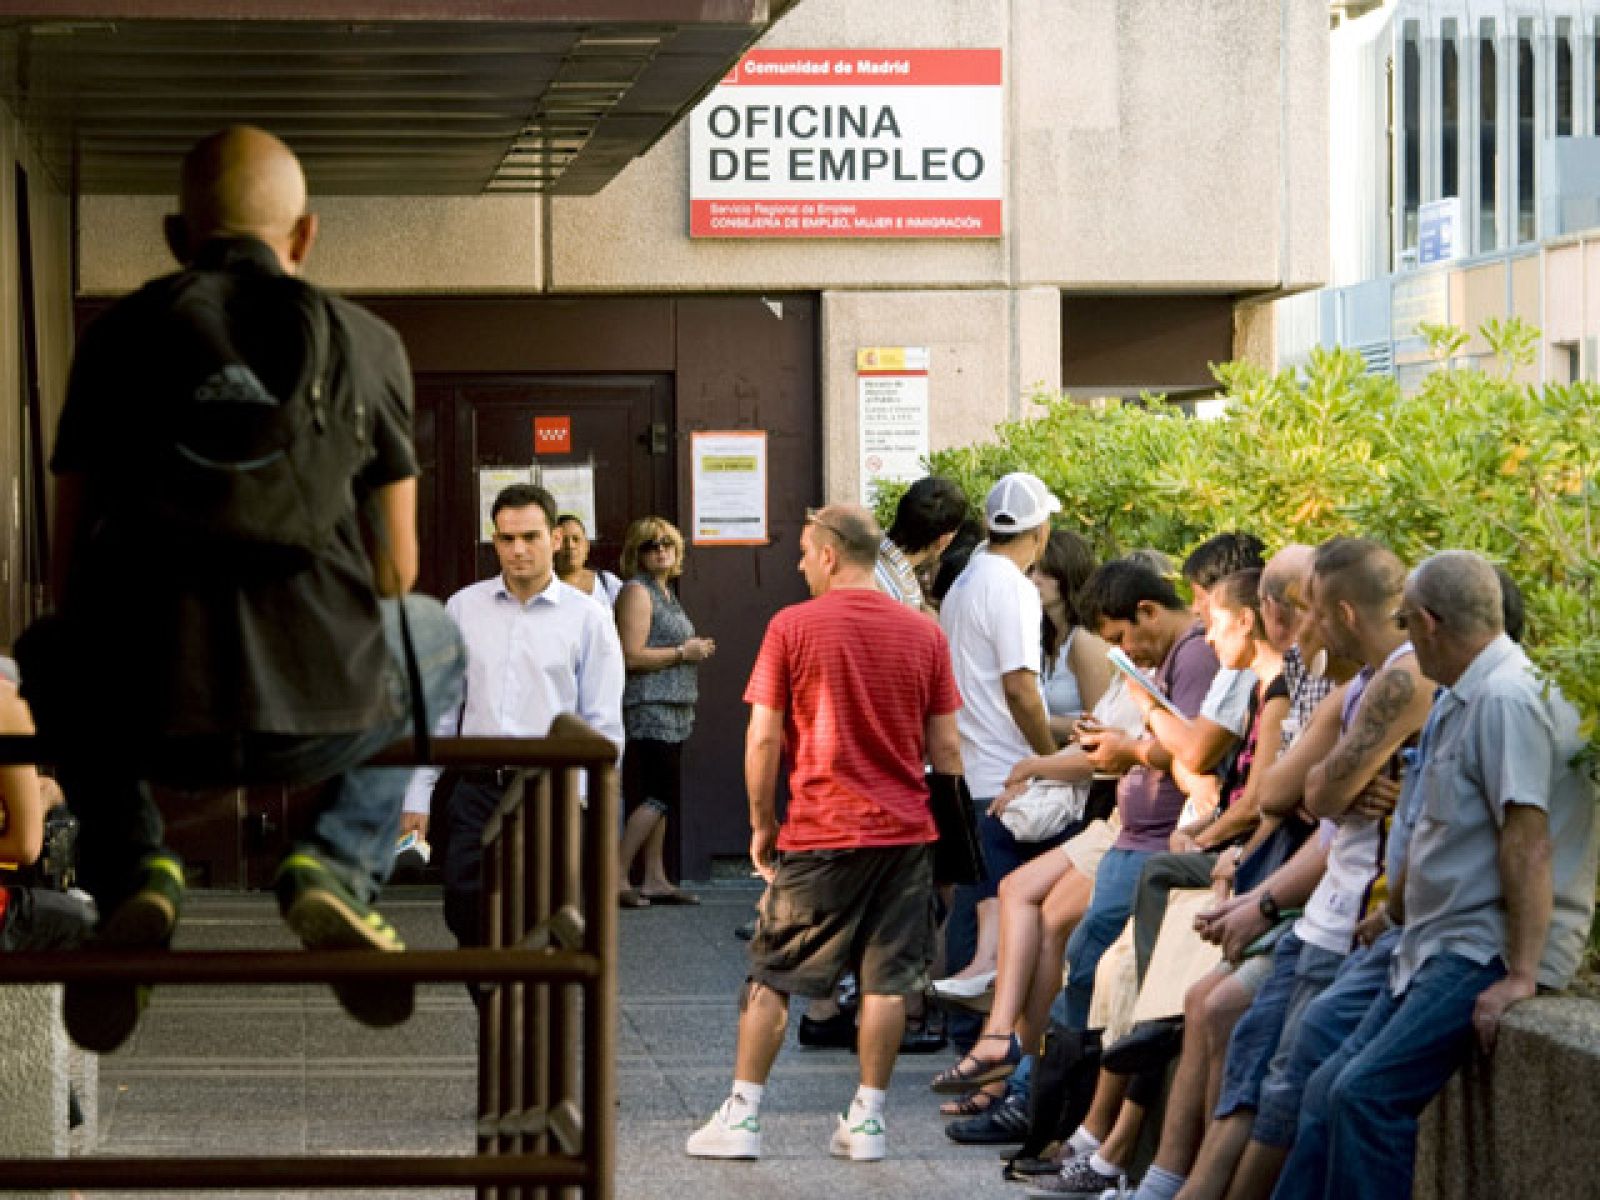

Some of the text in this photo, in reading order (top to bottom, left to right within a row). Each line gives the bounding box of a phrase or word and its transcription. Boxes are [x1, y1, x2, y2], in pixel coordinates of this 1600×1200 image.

[744, 59, 910, 74] Comunidad de Madrid
[708, 104, 902, 139] OFICINA
[709, 147, 986, 182] DE EMPLEO
[802, 204, 815, 214] de
[818, 204, 856, 216] Empleo
[785, 217, 799, 228] DE
[897, 217, 903, 228] E
